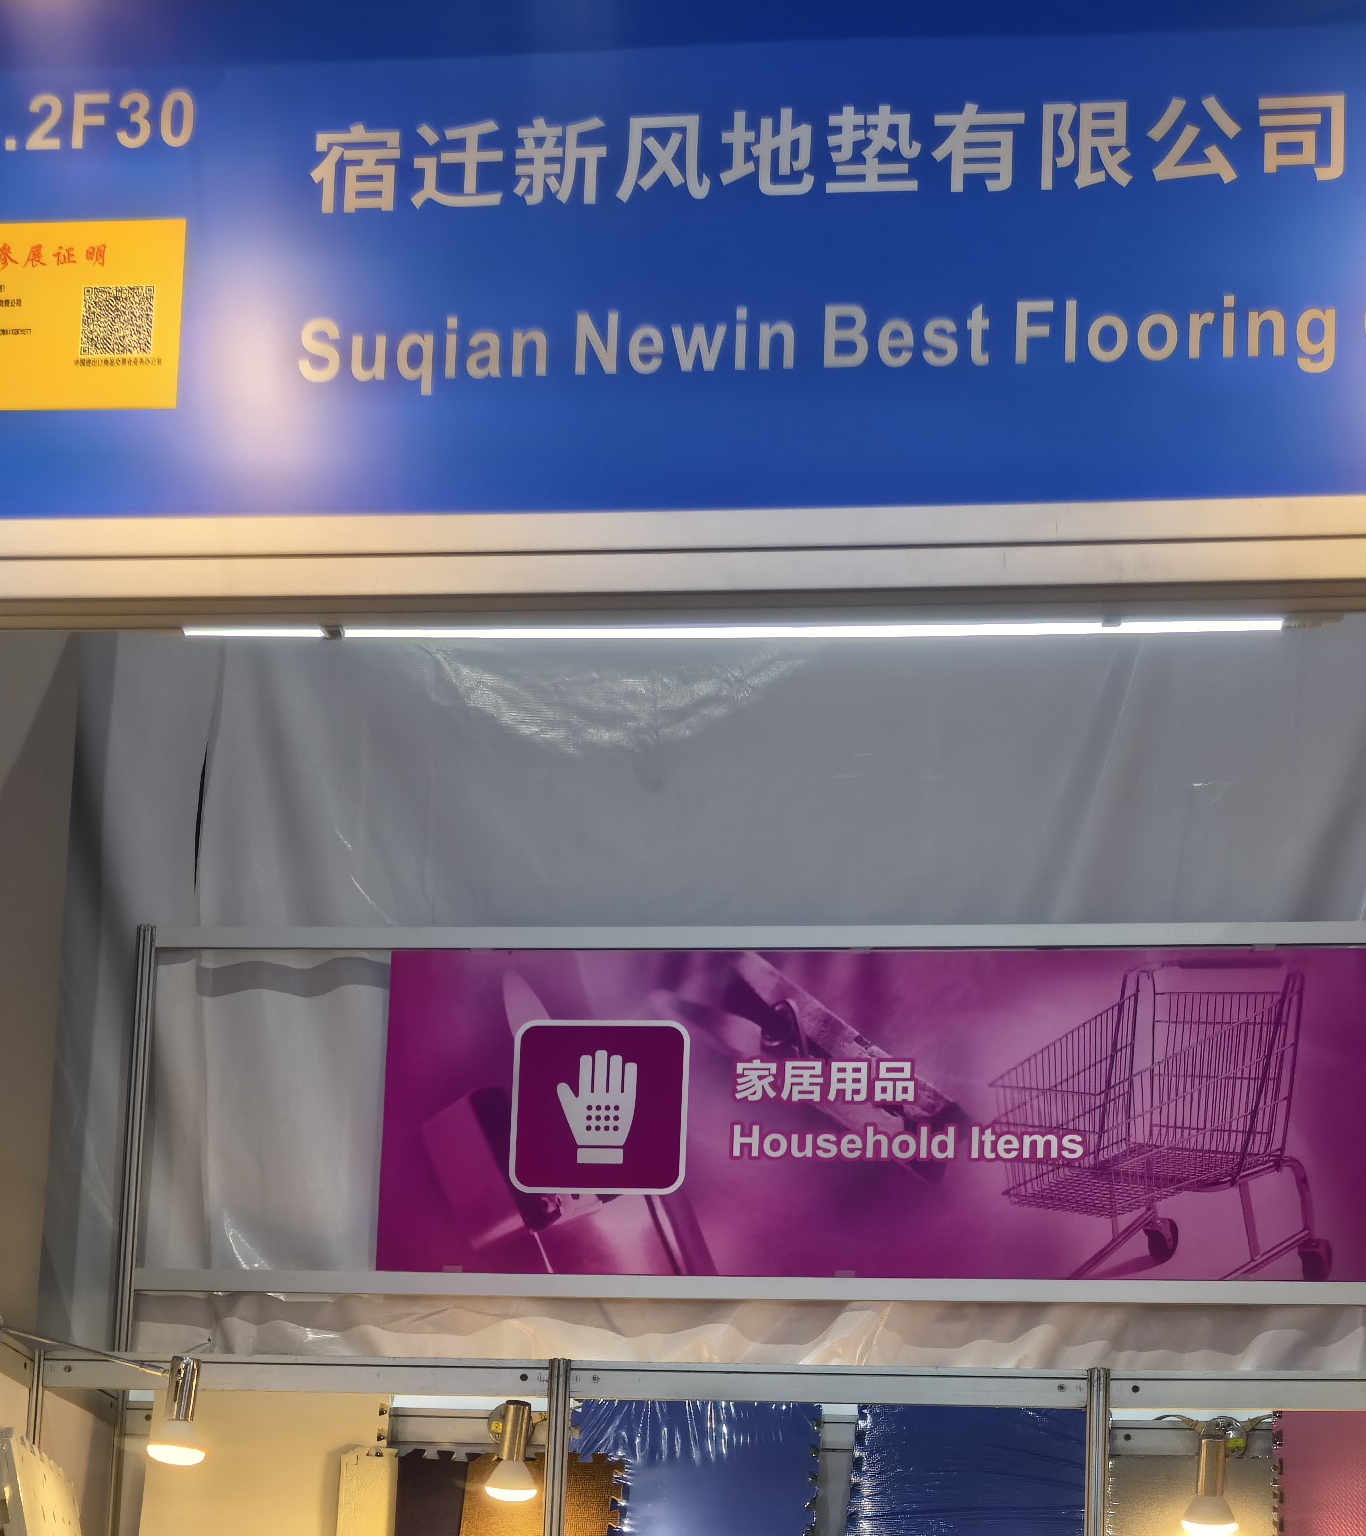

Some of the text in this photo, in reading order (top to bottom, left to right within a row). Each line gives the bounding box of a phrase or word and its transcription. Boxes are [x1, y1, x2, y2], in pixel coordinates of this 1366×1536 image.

[309, 94, 1349, 215] 宿迁新风地垫有限公司
[298, 314, 549, 395] Suqian
[575, 305, 796, 376] Newin
[823, 300, 990, 368] Best
[1014, 292, 1337, 373] Flooring
[733, 1059, 916, 1103] 家居用品
[730, 1125, 1084, 1160] Household Items
